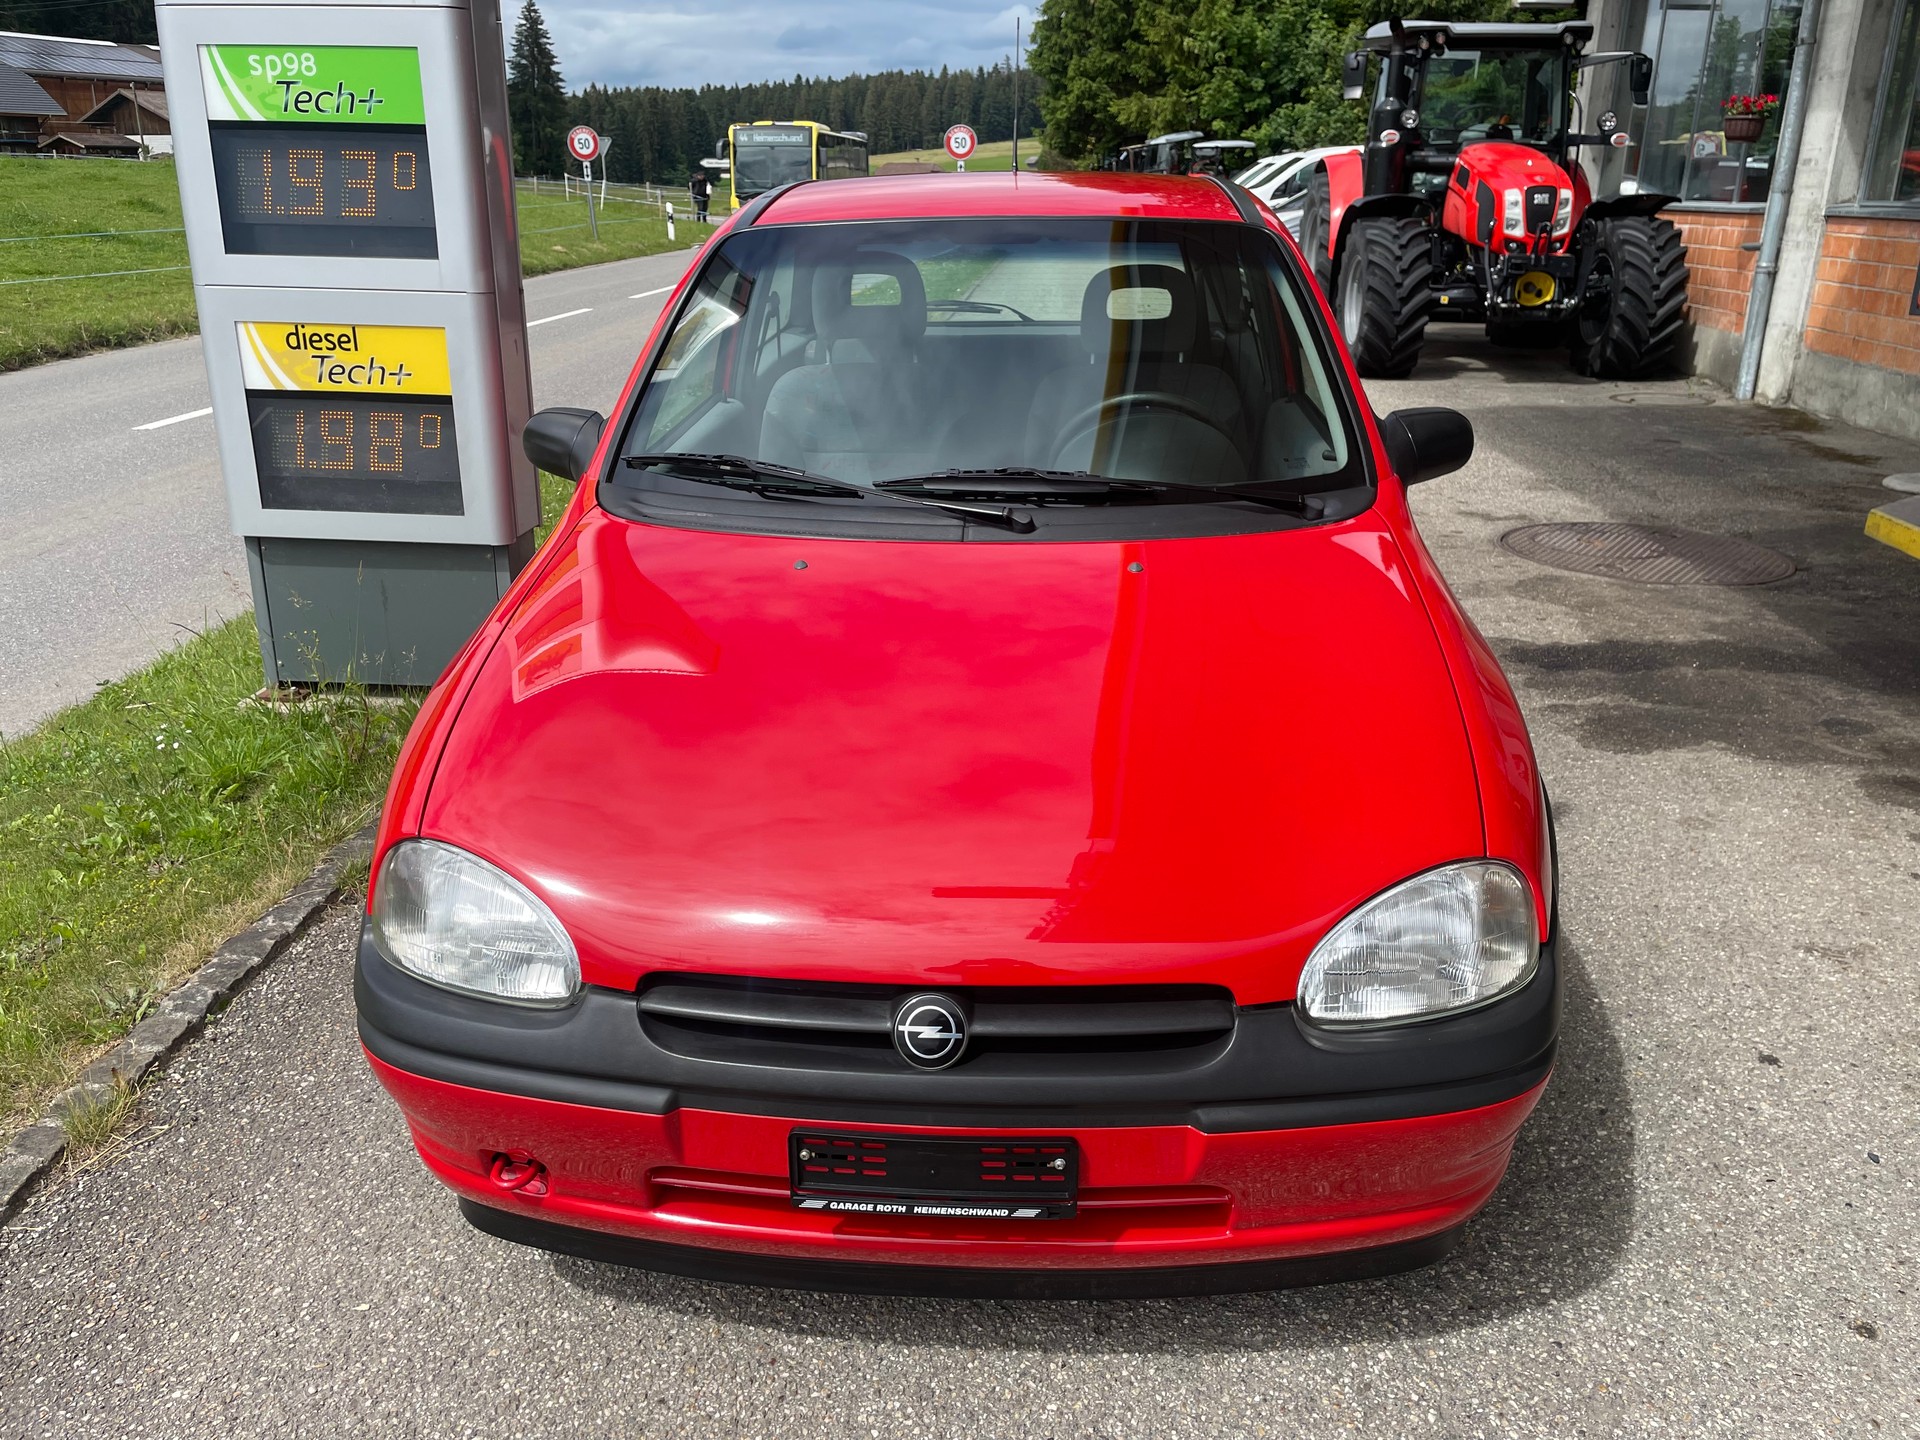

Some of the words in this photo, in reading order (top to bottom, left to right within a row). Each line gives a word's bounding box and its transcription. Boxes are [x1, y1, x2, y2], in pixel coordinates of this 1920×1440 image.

[248, 52, 317, 84] sp98
[275, 80, 384, 115] Tech+
[577, 138, 590, 150] 50
[954, 137, 967, 149] 50
[285, 324, 359, 352] diesel
[311, 354, 413, 387] Tech+
[829, 1201, 875, 1212] GARAGE
[876, 1204, 907, 1213] ROTH
[913, 1206, 1009, 1217] HEIMENSCHWAND
